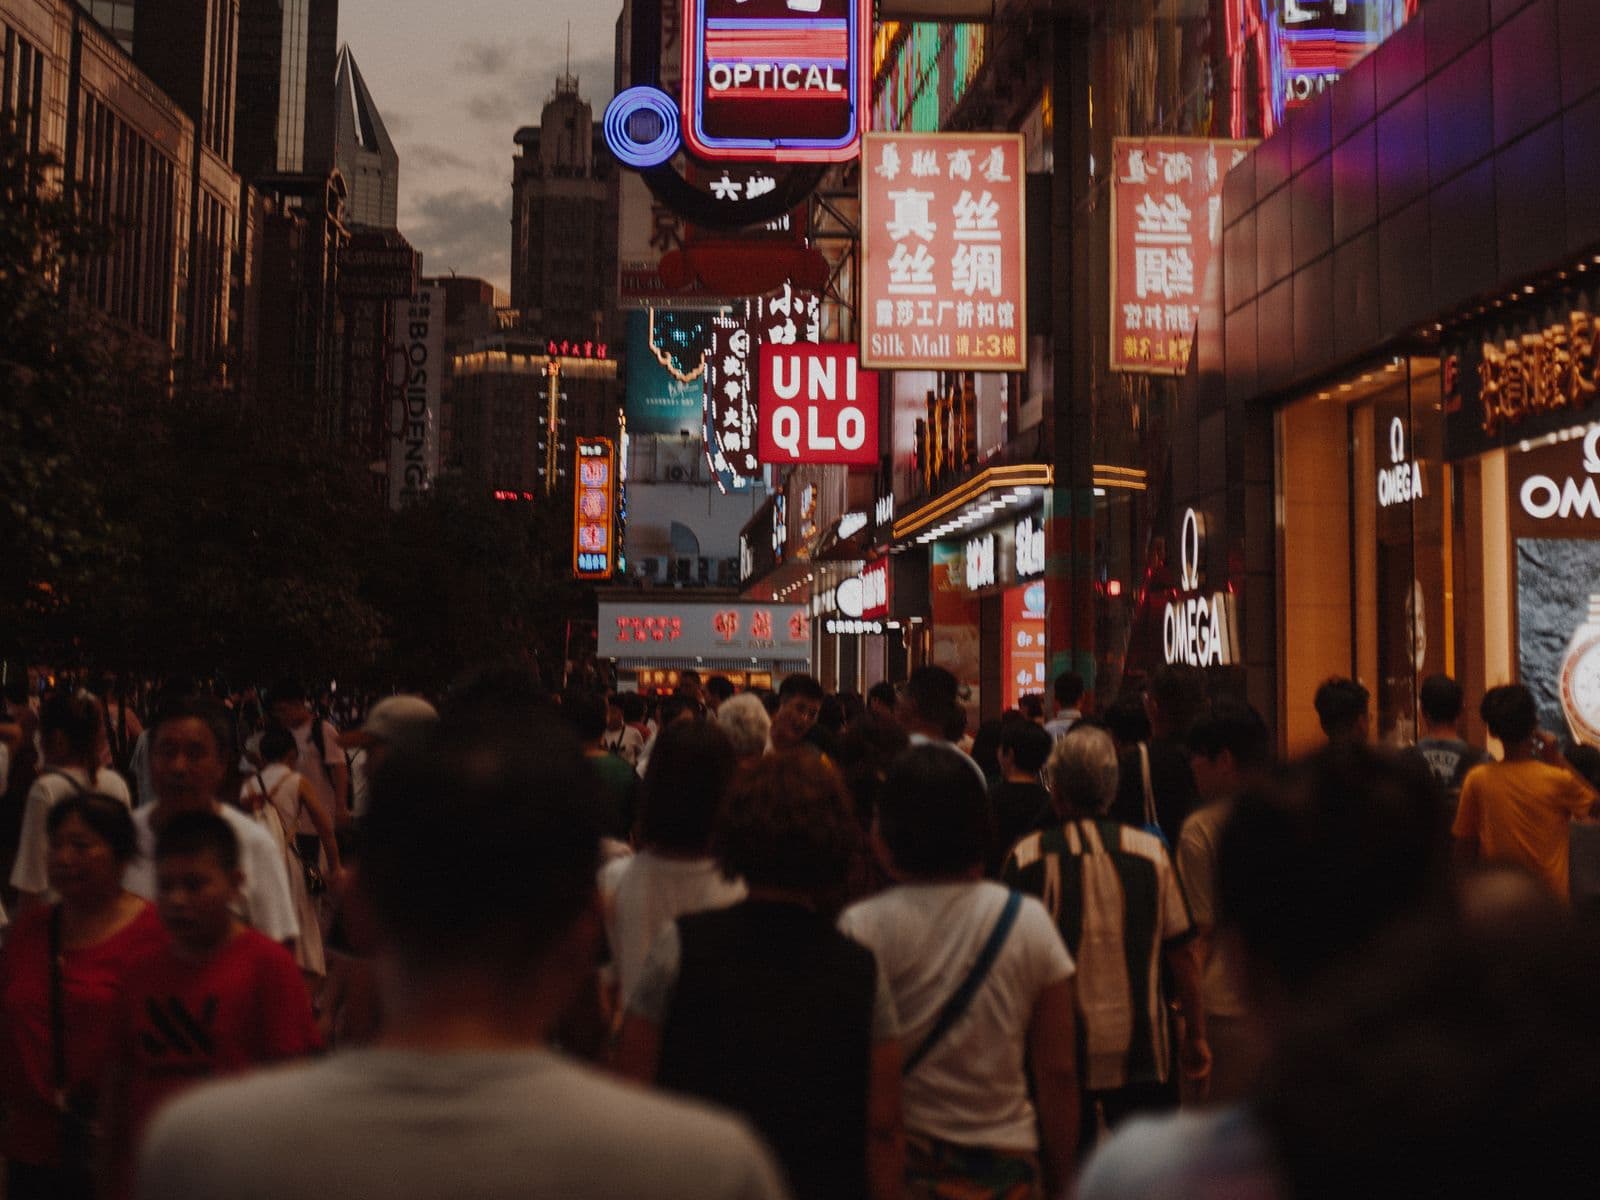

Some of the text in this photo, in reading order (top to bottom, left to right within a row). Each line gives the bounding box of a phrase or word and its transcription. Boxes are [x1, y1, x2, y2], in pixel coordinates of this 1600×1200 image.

[709, 63, 842, 92] OPTICAL
[872, 332, 905, 357] Silk
[911, 333, 951, 357] Mall
[772, 356, 857, 401] UNI
[405, 322, 428, 489] BOSIDENG
[772, 406, 865, 457] QLO
[1378, 460, 1423, 507] OMEGA
[1163, 596, 1223, 667] OMEGA
